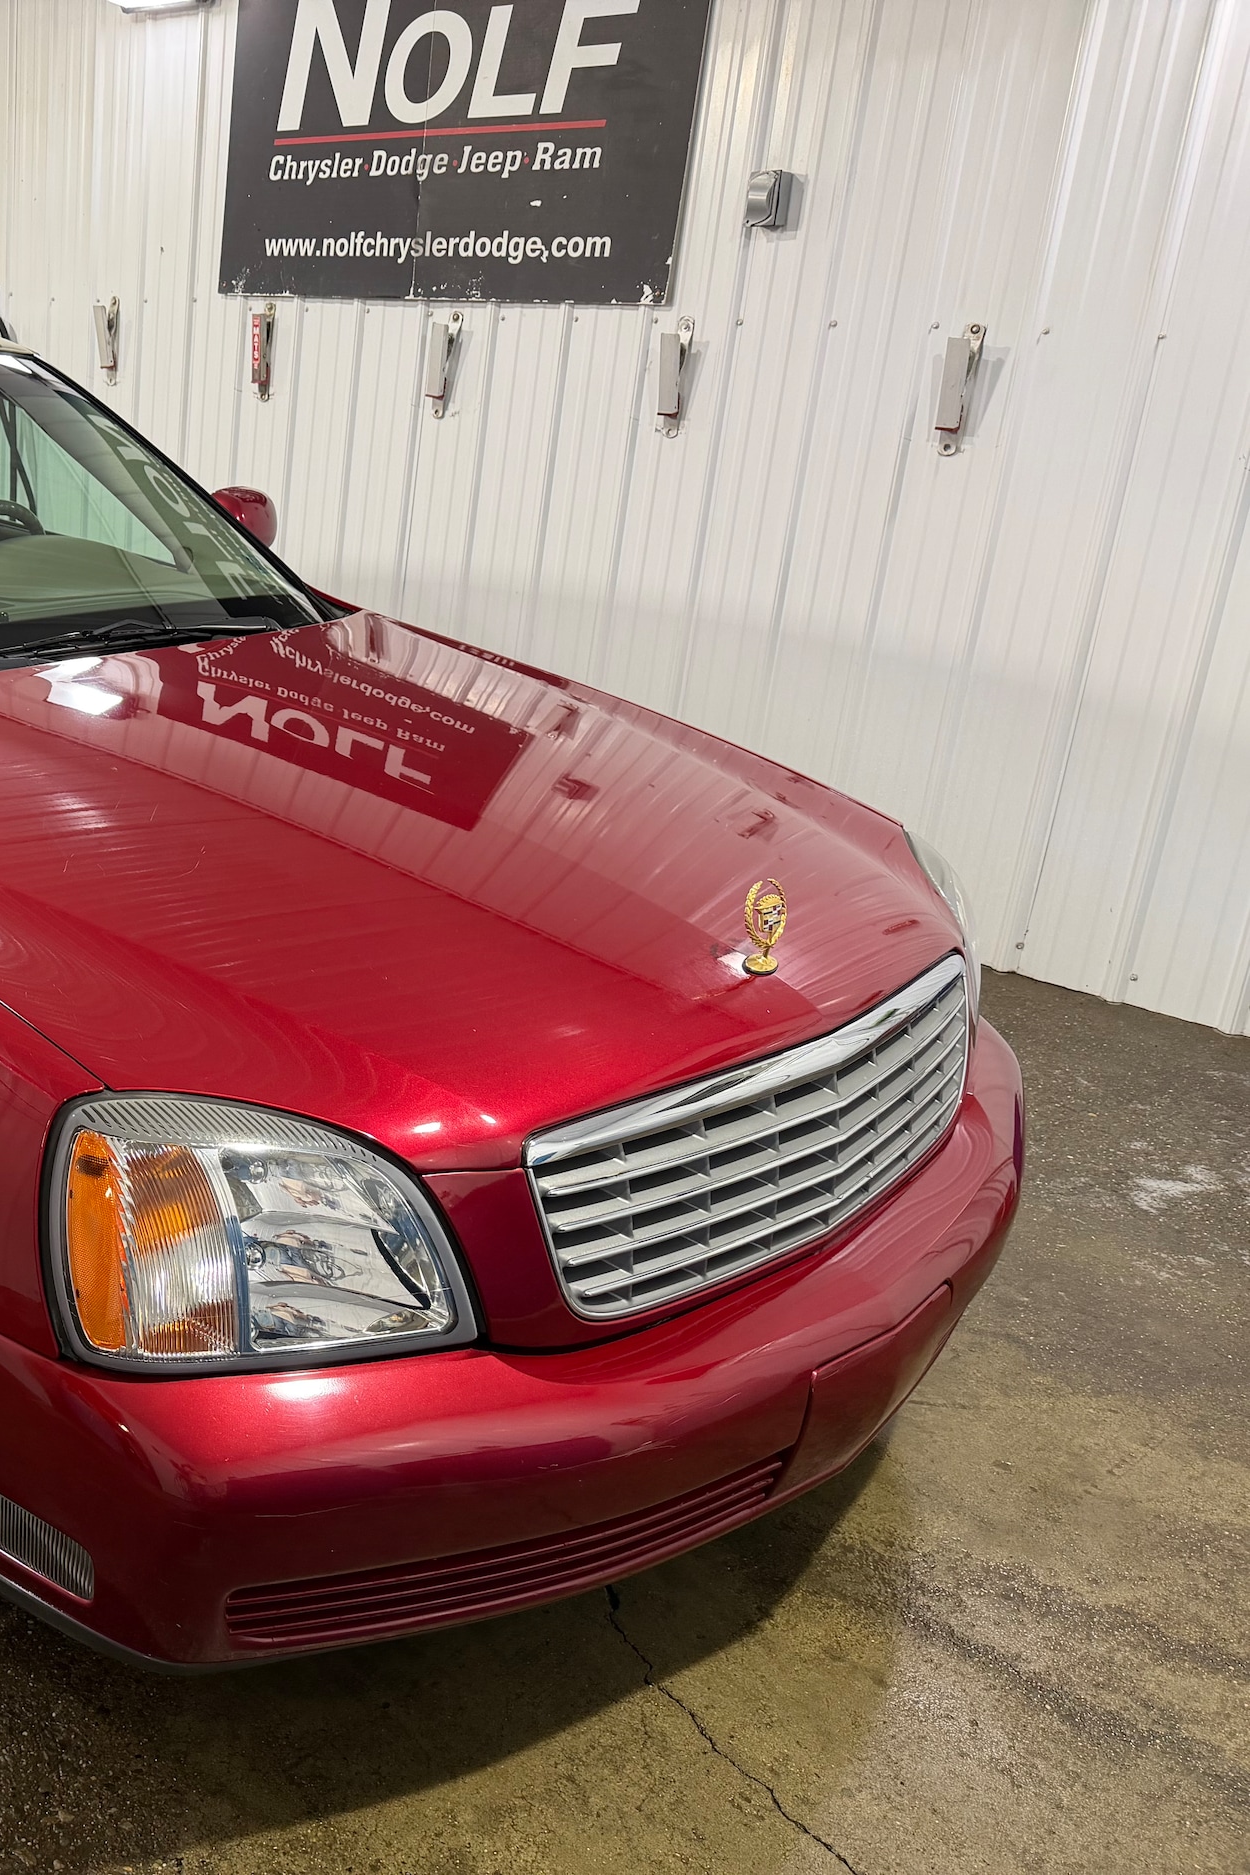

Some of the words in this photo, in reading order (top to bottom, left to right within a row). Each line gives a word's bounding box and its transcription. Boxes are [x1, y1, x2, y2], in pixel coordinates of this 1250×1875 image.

[277, 0, 640, 132] NOLF
[268, 152, 364, 186] Chrysler
[370, 147, 448, 181] Dodge
[456, 145, 524, 179] Jeep
[532, 142, 603, 171] Ram
[265, 231, 612, 264] www.nolfchryslerdodge.com
[252, 326, 260, 359] MATS
